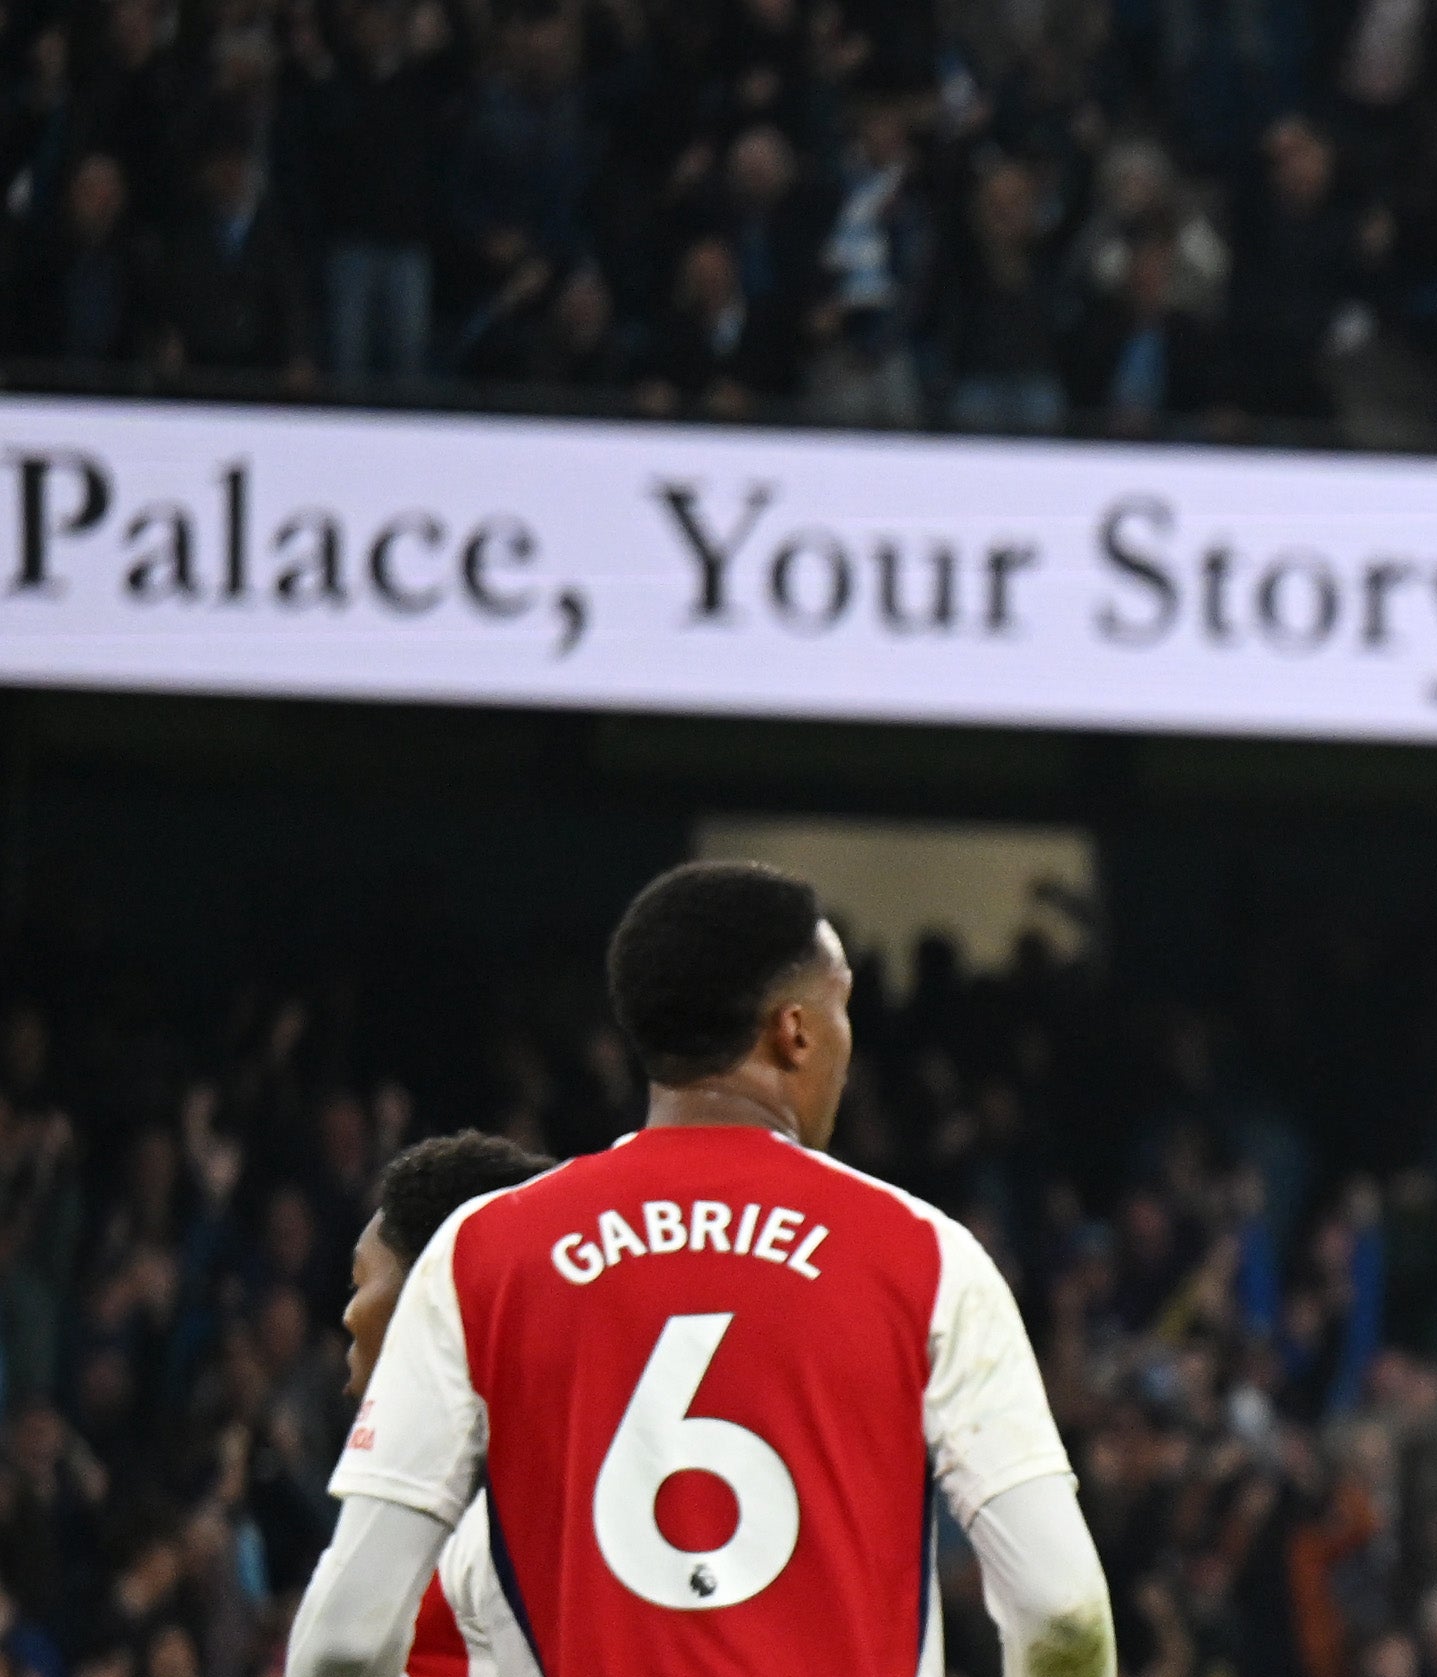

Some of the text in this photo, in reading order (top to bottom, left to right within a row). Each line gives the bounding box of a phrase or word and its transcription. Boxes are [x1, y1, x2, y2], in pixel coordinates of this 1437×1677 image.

[3, 449, 588, 658] Palace,
[645, 479, 1042, 636] Your
[550, 1200, 831, 1285] GABRIEL
[592, 1311, 800, 1611] 6
